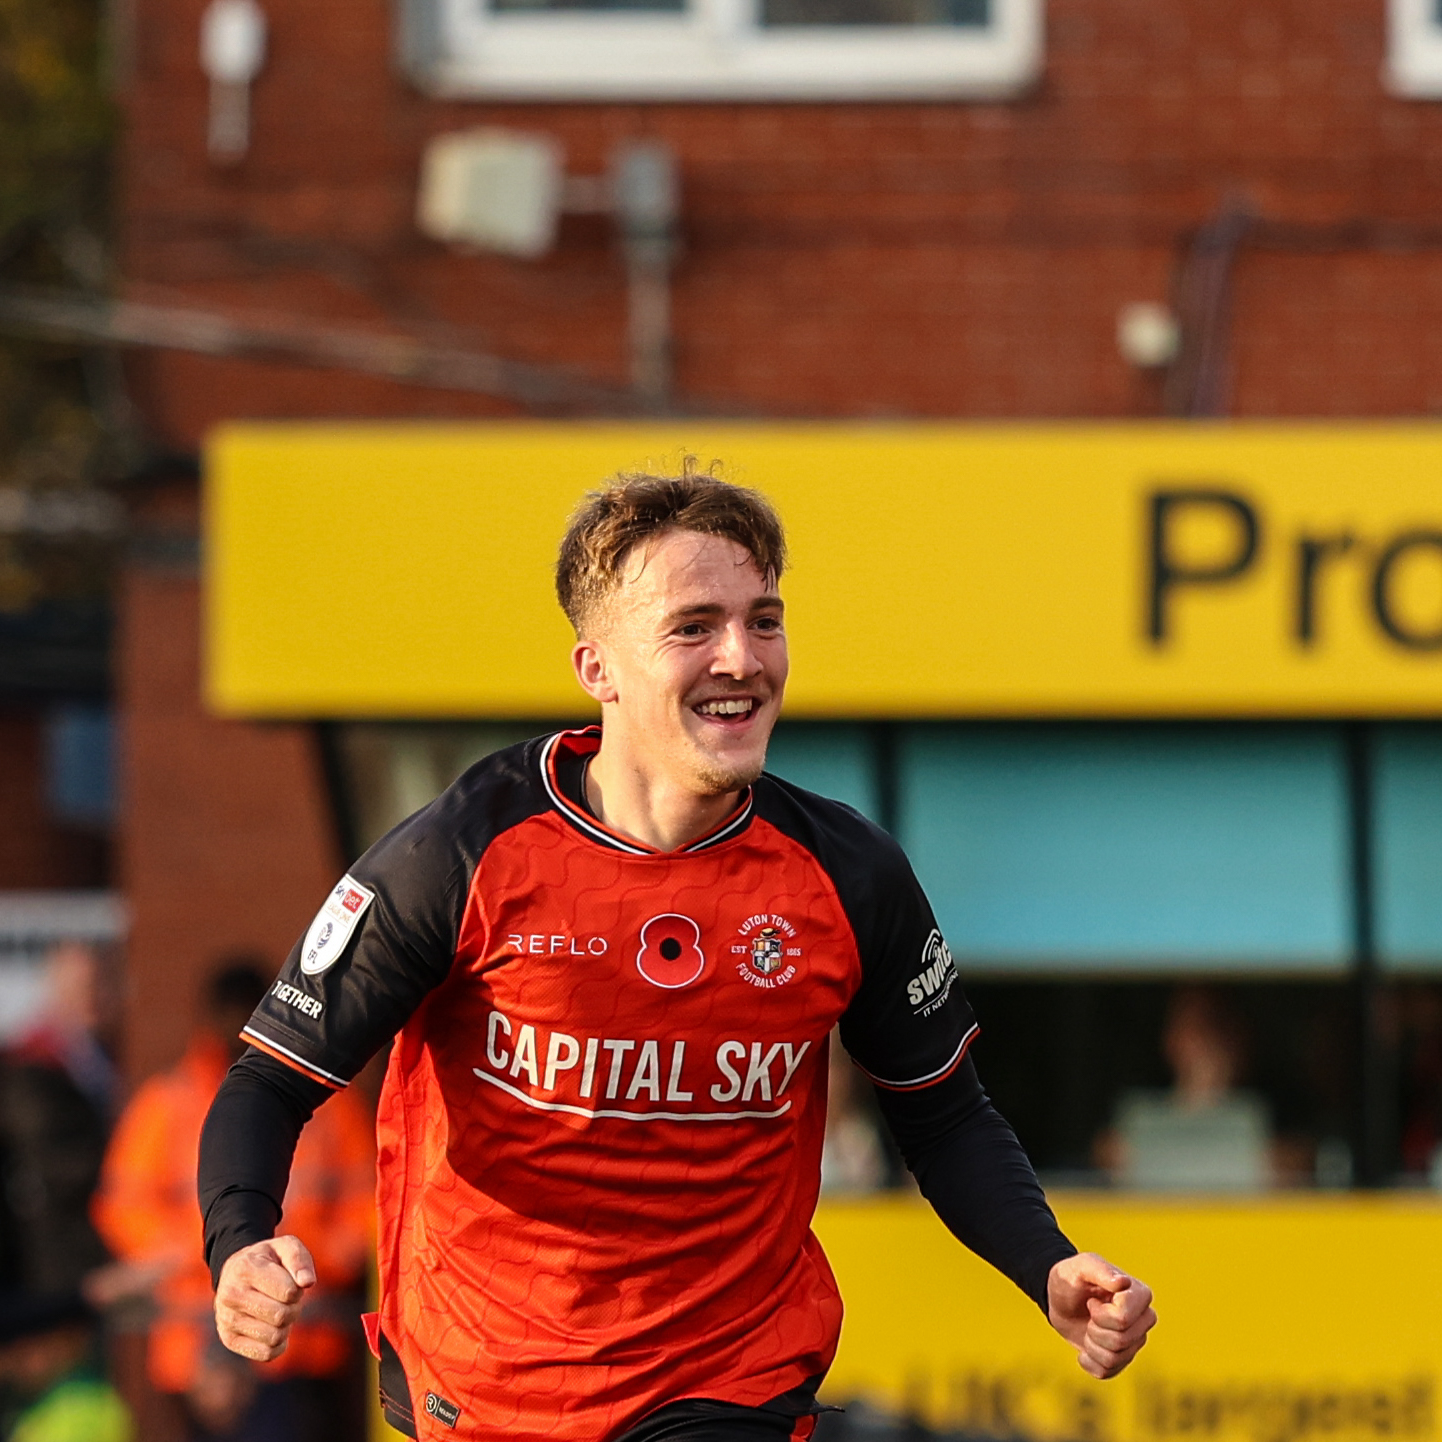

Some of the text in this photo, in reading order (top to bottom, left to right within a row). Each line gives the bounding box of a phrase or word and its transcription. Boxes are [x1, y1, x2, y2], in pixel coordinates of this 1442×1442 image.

[738, 914, 797, 938] LUTON TOWN
[307, 948, 318, 964] EFL
[508, 934, 608, 956] REFLO
[731, 946, 747, 954] EST
[736, 962, 796, 988] FOOTBALL CLUB
[486, 1010, 812, 1102] CAPITAL SKY
